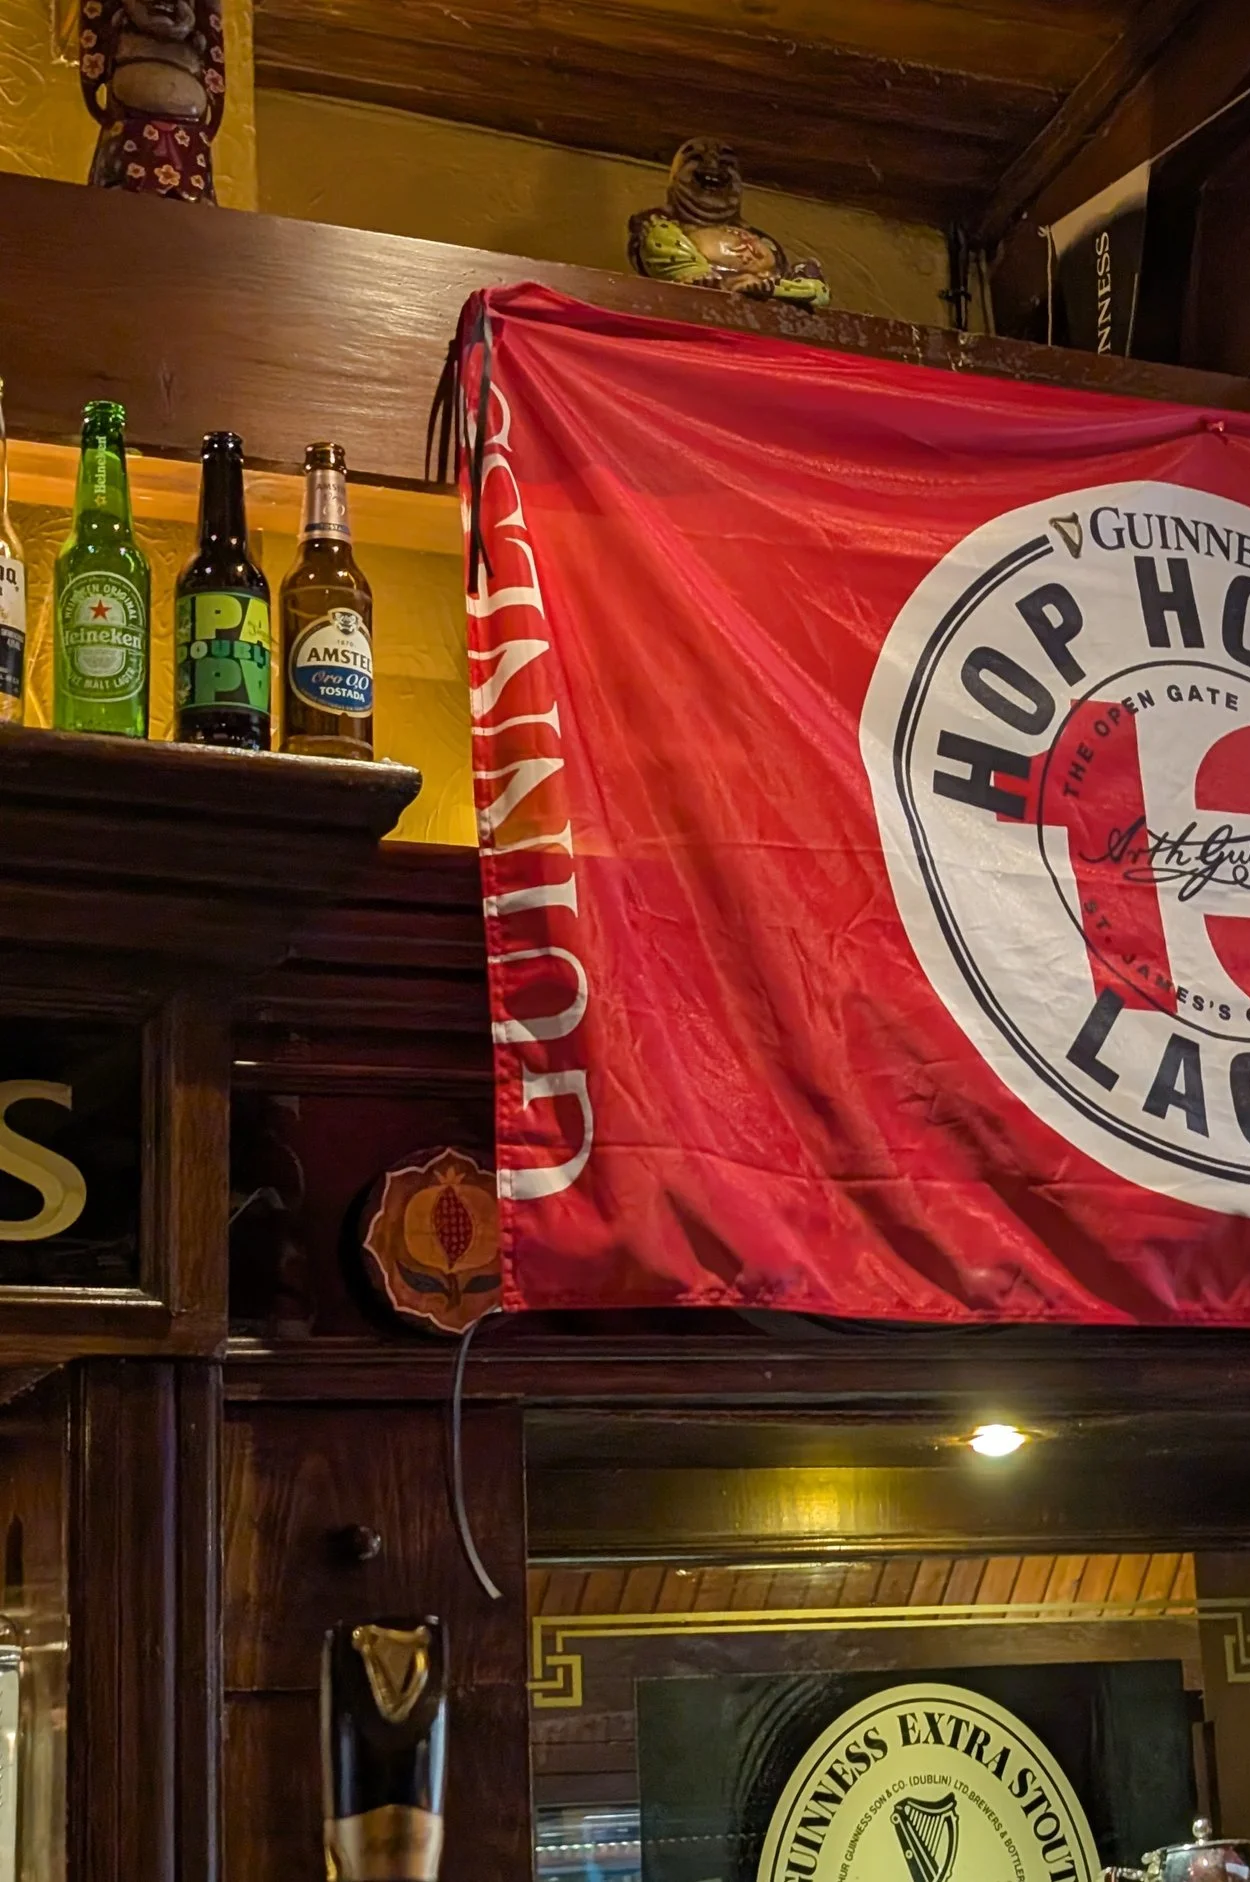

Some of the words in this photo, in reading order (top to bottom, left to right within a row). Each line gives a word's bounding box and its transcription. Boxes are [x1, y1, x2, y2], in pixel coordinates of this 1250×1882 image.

[103, 583, 138, 620] ORIGINAL
[306, 647, 373, 674] AMSTEL
[319, 686, 366, 703] TOSTADA
[932, 582, 1085, 821] HOP
[1062, 740, 1096, 799] THE
[1094, 688, 1156, 738] OPEN
[1166, 684, 1240, 713] GATE
[1083, 900, 1114, 945] ST.
[1122, 950, 1234, 1022] JAMES'S
[784, 1726, 889, 1882] UINNESS
[897, 1711, 1011, 1781] EXTRA
[844, 1812, 873, 1862] GUINNESS
[869, 1793, 888, 1815] SON
[886, 1789, 893, 1798] &
[909, 1774, 952, 1787] (DUBLIN)
